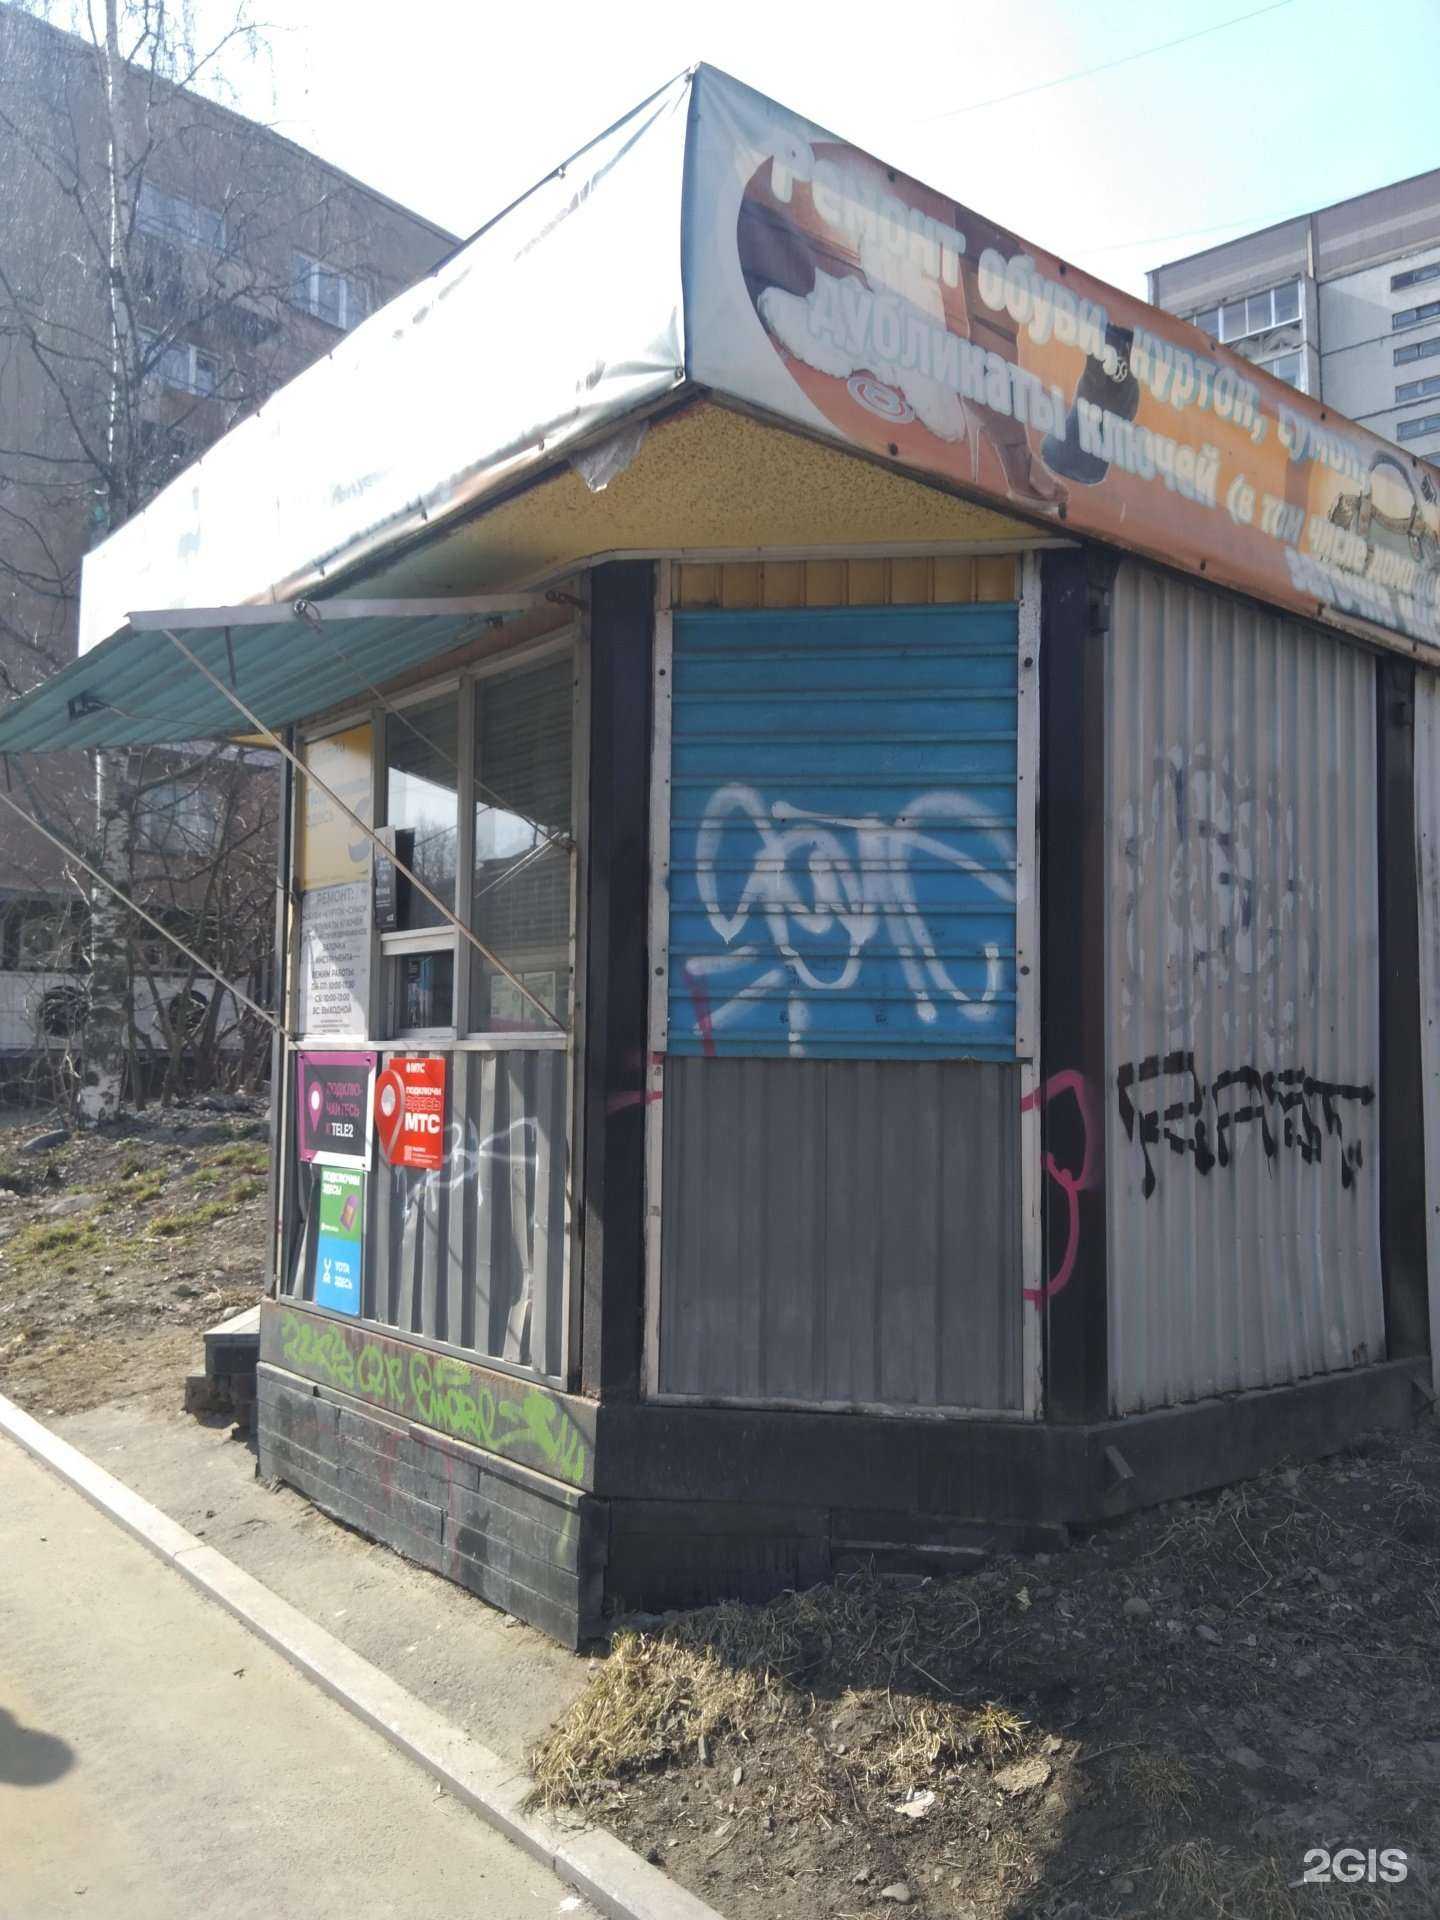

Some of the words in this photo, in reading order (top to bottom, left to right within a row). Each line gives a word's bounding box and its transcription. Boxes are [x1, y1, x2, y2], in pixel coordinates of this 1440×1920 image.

[770, 134, 966, 289] Ремонт
[977, 247, 1118, 377] обуви,
[1130, 325, 1268, 444] курток,
[1076, 397, 1221, 509] ключей
[331, 1122, 354, 1138] TELE2
[404, 1112, 441, 1134] МТС
